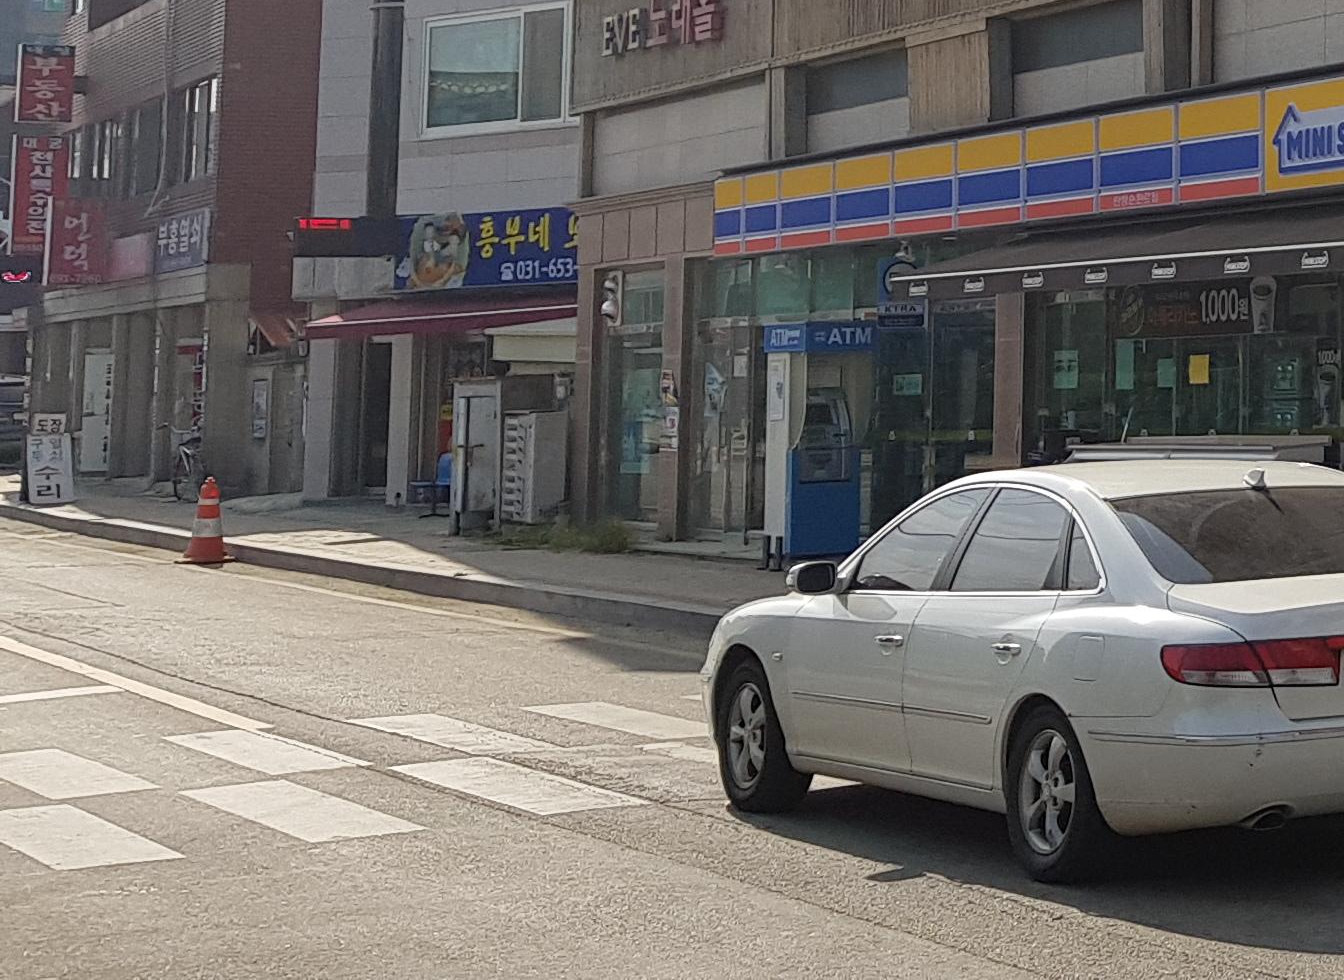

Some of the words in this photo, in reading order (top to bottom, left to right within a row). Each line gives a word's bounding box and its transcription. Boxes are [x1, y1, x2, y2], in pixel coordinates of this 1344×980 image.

[603, 7, 640, 58] EVE
[25, 56, 66, 121] 부동산
[1286, 123, 1333, 162] MINI
[475, 212, 551, 260] 흥부네
[827, 327, 873, 345] ATM
[36, 418, 62, 434] 도장
[33, 465, 61, 499] 수리
